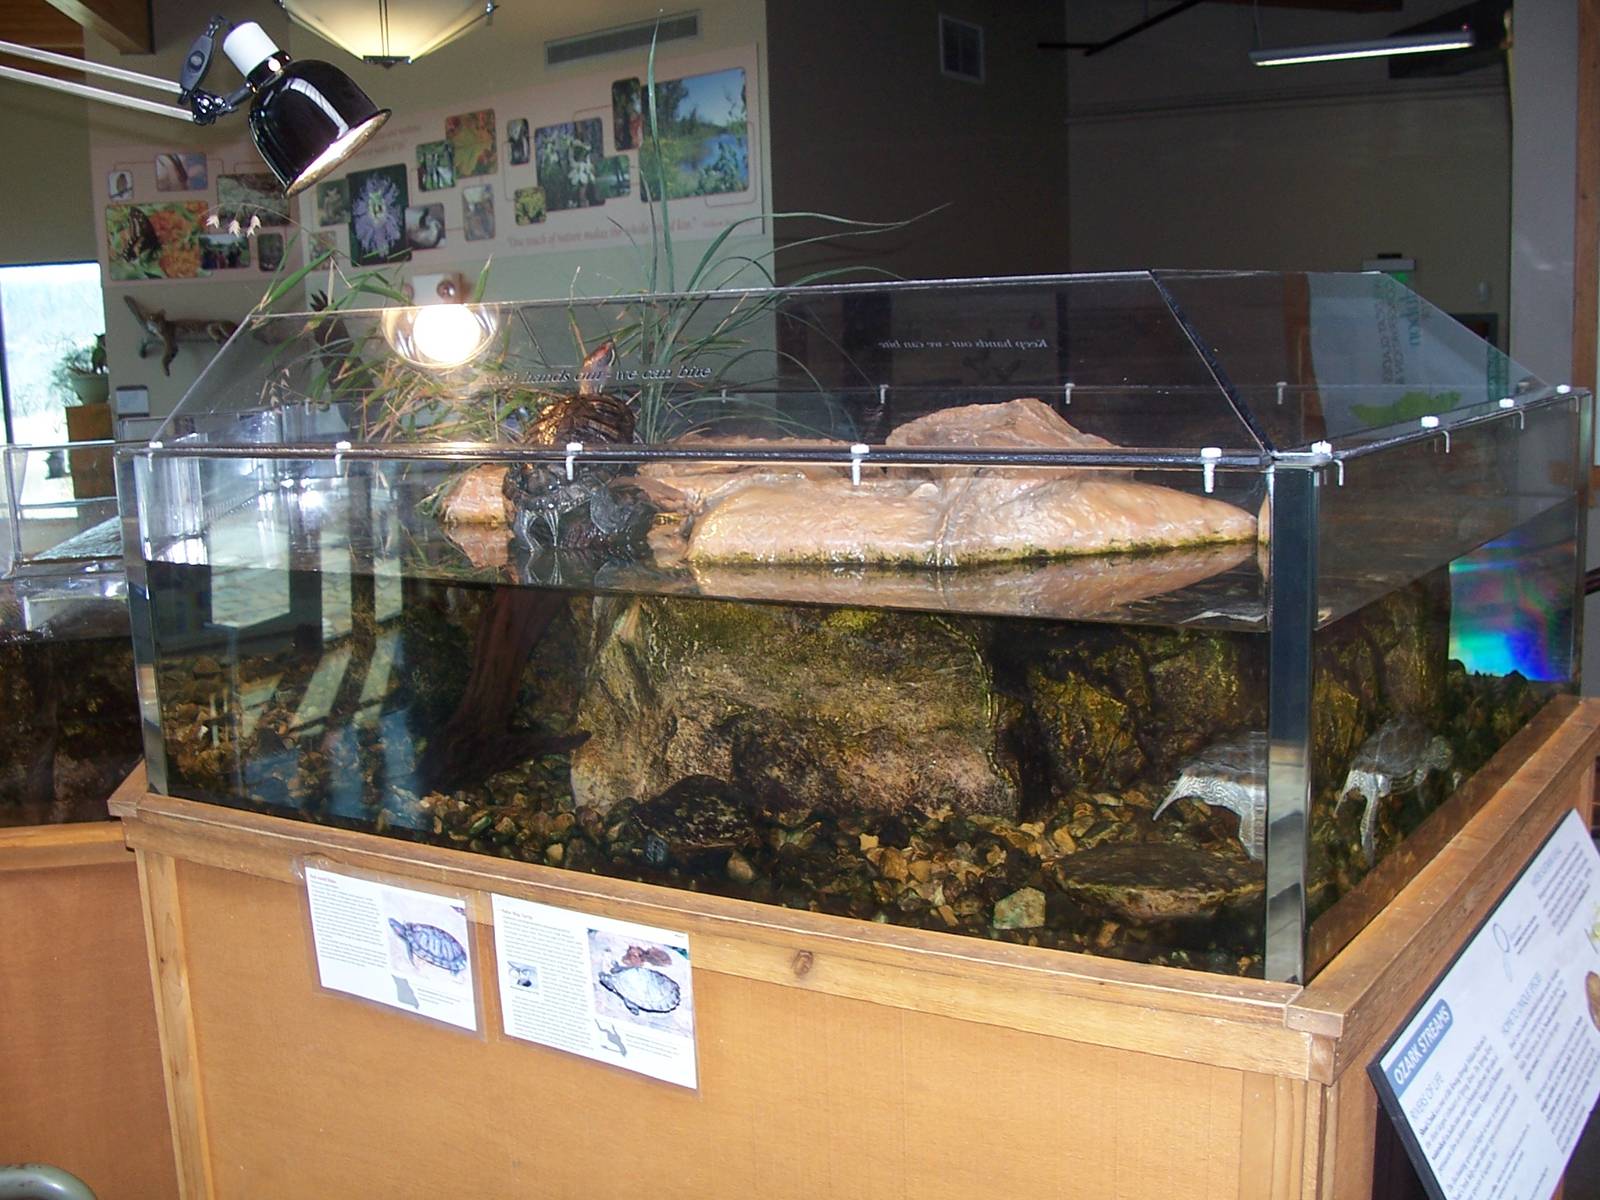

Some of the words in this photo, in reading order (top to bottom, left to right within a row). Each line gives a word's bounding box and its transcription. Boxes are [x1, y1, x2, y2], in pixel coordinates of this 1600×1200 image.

[522, 369, 570, 384] hands
[574, 369, 602, 382] out
[615, 369, 638, 381] we
[642, 368, 673, 380] can
[677, 364, 712, 379] bite
[1393, 1040, 1422, 1085] OZARK
[1416, 1004, 1450, 1056] STREAMS
